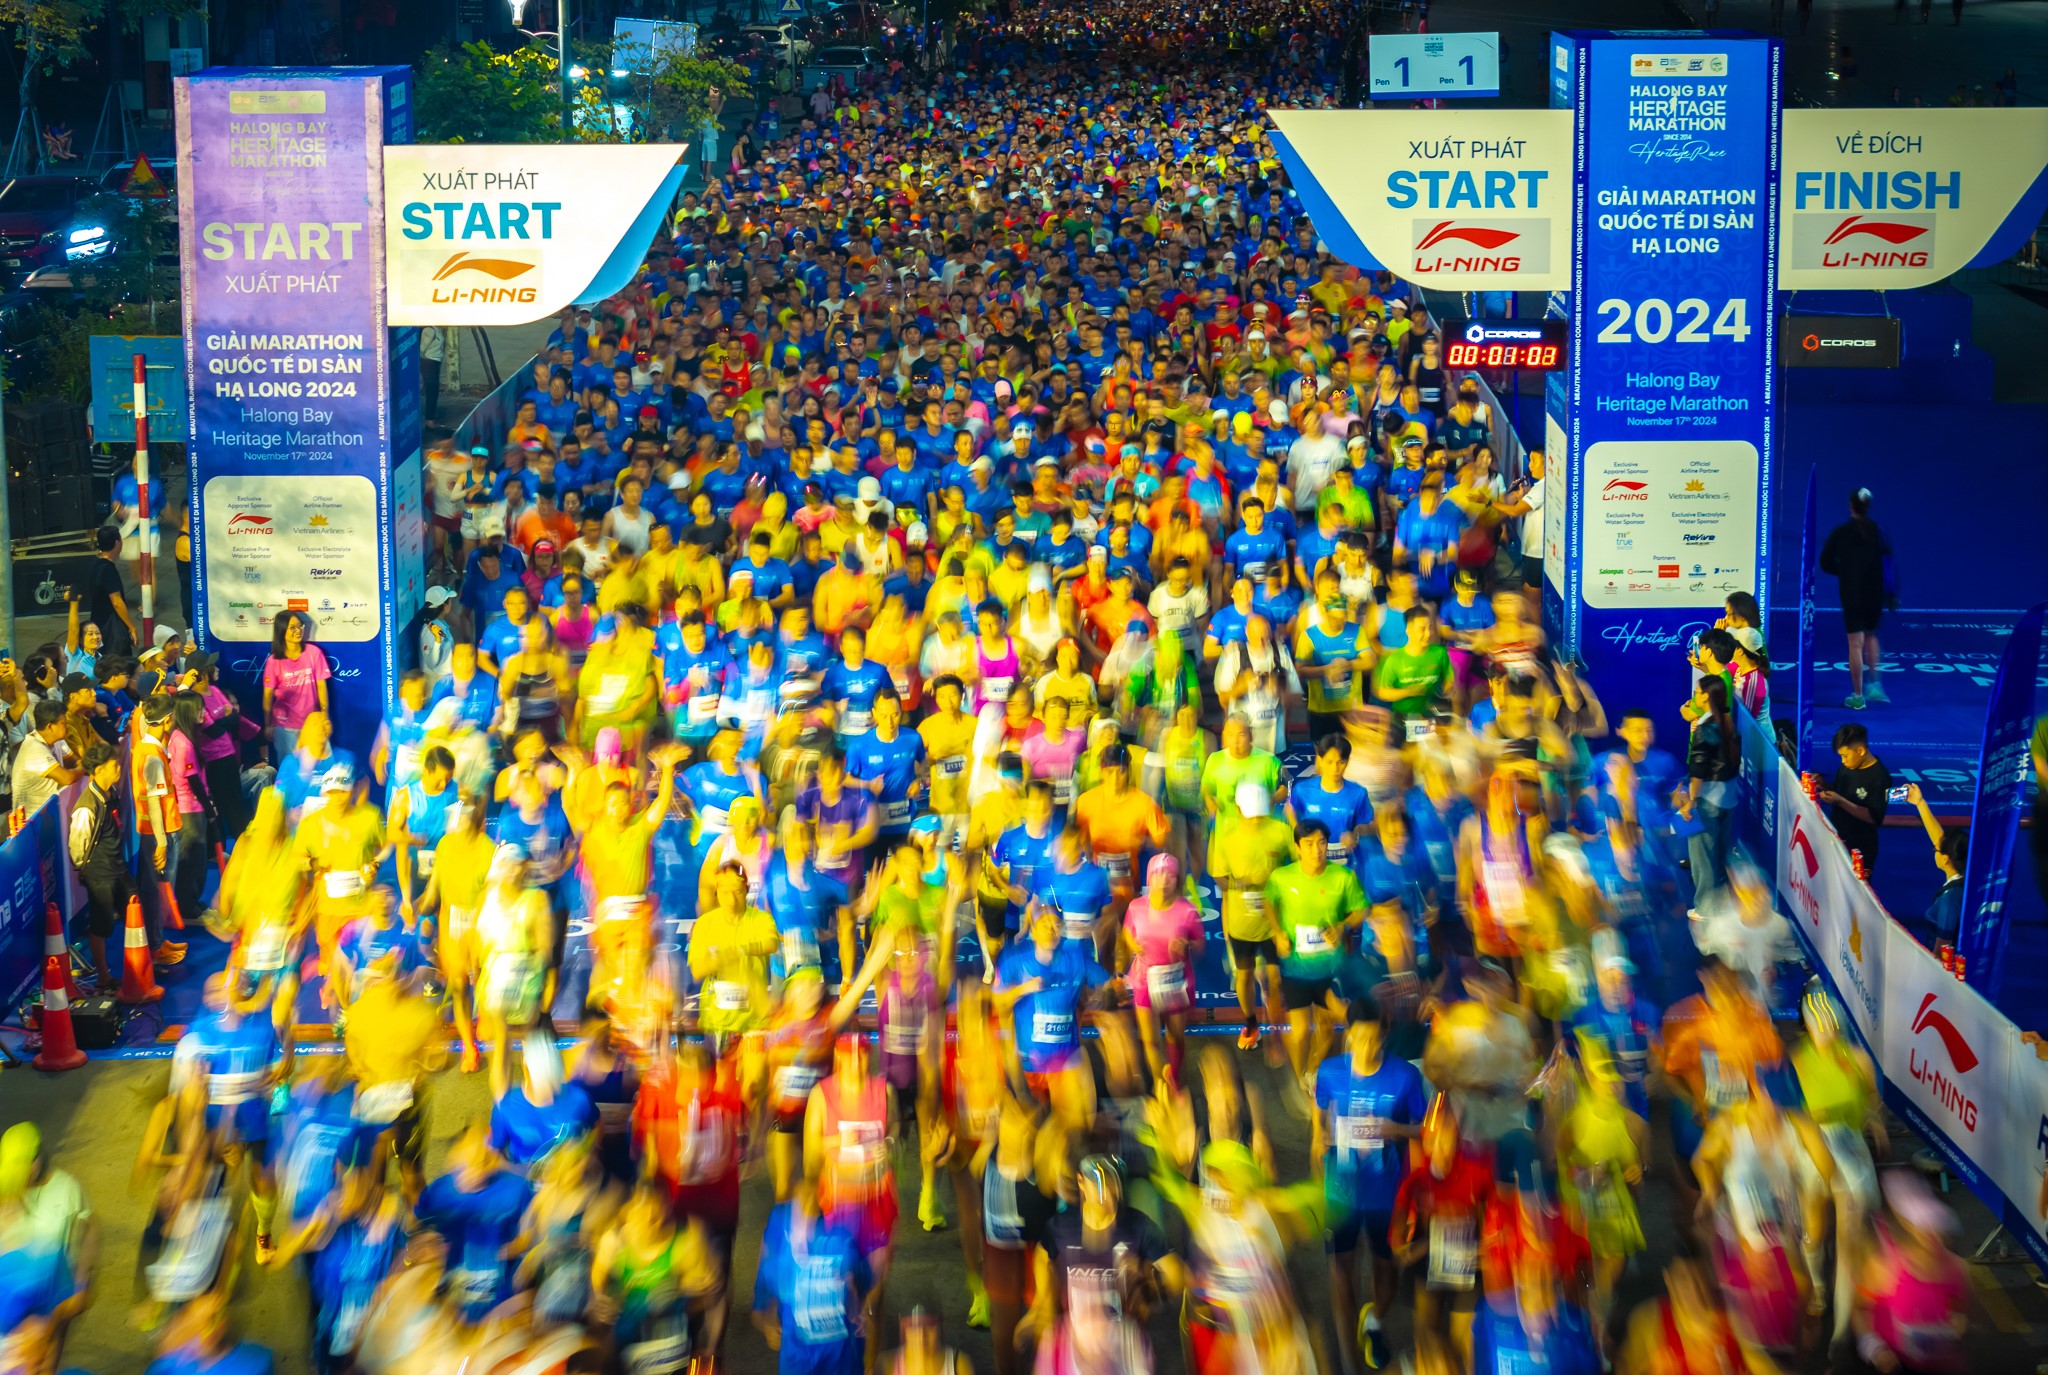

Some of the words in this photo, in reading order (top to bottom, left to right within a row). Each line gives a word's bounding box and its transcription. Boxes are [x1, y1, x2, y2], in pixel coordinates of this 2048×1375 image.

[1375, 78, 1390, 86] Pen
[1394, 57, 1410, 87] 1
[1439, 77, 1454, 85] Pen
[1458, 55, 1473, 86] 1
[1578, 65, 1586, 101] MARATHON
[1630, 85, 1693, 97] HALONG
[1697, 85, 1728, 97] BAY
[1578, 101, 1586, 131] HERITAGE
[1629, 100, 1726, 117] HERITAGE
[230, 122, 293, 134] HALONG
[297, 122, 327, 134] BAY
[1628, 117, 1726, 131] MARATHON
[230, 137, 327, 154] HERITAGE
[1409, 135, 1462, 159] XUẤT
[1471, 136, 1527, 159] PHÁT
[1629, 138, 1690, 164] Heritage
[1684, 140, 1727, 161] Race
[1836, 130, 1863, 154] VỀ
[1868, 131, 1922, 154] ĐÍCH
[230, 155, 327, 168] MARATHON
[1577, 145, 1585, 171] HALONG
[422, 167, 479, 191] XUẤT
[484, 168, 539, 190] PHÁT
[1386, 170, 1549, 209] START
[1795, 171, 1961, 210] FINISH
[1597, 186, 1638, 205] GIẢI
[1642, 189, 1756, 205] MARATHON
[402, 202, 562, 240] START
[1576, 198, 1584, 227] HERITAGE
[1598, 209, 1658, 231] QUỐC
[1661, 209, 1685, 229] TẾ
[1689, 213, 1709, 229] DI
[1712, 209, 1754, 229] SẢN
[203, 222, 362, 261] START
[1576, 228, 1584, 254] UNESCO
[1632, 238, 1660, 258] HẠ
[1665, 238, 1720, 253] LONG
[1415, 256, 1521, 272] LI-NING
[1576, 260, 1583, 269] BY
[1822, 252, 1929, 267] LI-NING
[225, 270, 281, 293] XUẤT
[287, 271, 341, 293] PHÁT
[1575, 270, 1583, 312] SURROUNDED
[432, 288, 537, 303] LI-NING
[1574, 312, 1582, 338] COURSE
[1597, 298, 1751, 343] 2024
[206, 330, 246, 350] GIẢI
[250, 335, 363, 350] MARATHON
[1820, 339, 1877, 347] COROS
[208, 354, 267, 374] QUỐC
[271, 354, 294, 374] TẾ
[299, 358, 317, 374] DI
[321, 354, 362, 374] SẢN
[1574, 338, 1582, 367] RUNNING
[216, 382, 245, 402] HẠ
[249, 382, 302, 398] LONG
[306, 381, 357, 398] 2024
[1573, 368, 1581, 400] BEAUTIFUL
[1626, 372, 1684, 390] Halong
[1689, 372, 1720, 390] Bay
[241, 408, 299, 425] Halong
[303, 408, 333, 425] Bay
[1596, 396, 1666, 414] Heritage
[1670, 396, 1748, 411] Marathon
[1573, 418, 1581, 434] 2024
[1627, 417, 1673, 426] November
[1675, 417, 1691, 426] 17th
[1692, 417, 1717, 426] 2024
[213, 431, 282, 448] Heritage
[286, 431, 363, 446] Marathon
[244, 452, 289, 460] November
[291, 452, 307, 460] 17th
[309, 452, 333, 460] 2024
[228, 527, 274, 535] LI-NING
[1571, 510, 1579, 545] MARATHON
[382, 543, 390, 578] MARATHON
[244, 572, 261, 580] true
[1570, 583, 1578, 612] HERITAGE
[1602, 619, 1680, 652] Heritage
[1788, 862, 1820, 927] LI-NING
[1909, 1047, 1978, 1133] LI-NING
